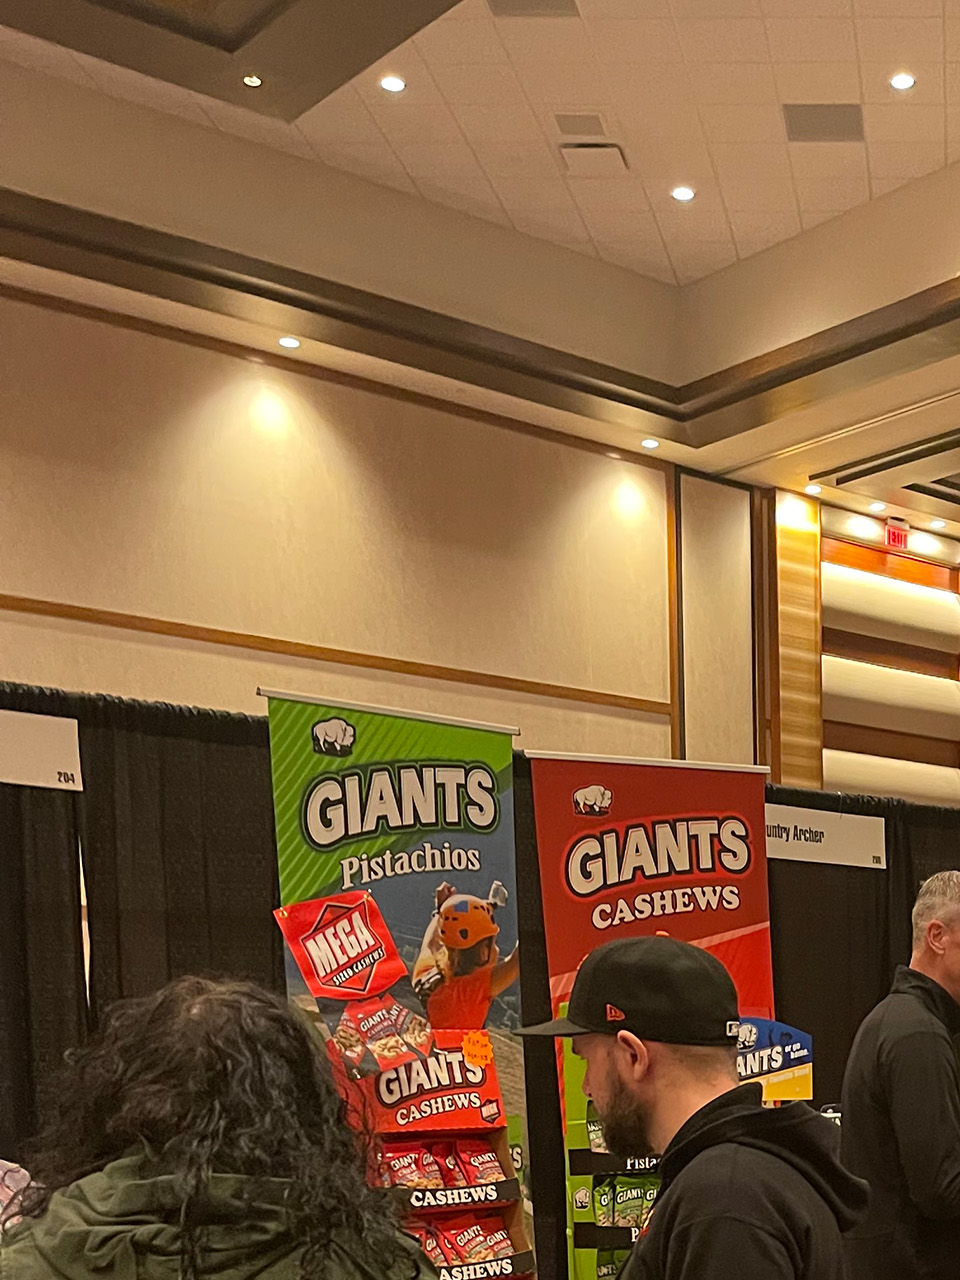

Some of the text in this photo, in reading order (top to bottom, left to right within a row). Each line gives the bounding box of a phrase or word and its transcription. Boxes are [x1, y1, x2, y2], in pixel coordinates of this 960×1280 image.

[306, 766, 496, 846] GIANTS
[766, 824, 825, 843] untry Archer
[340, 842, 481, 890] Pistachios
[568, 819, 749, 895] GIANTS
[592, 885, 740, 929] CASHEWS
[306, 911, 375, 978] MEGA
[332, 948, 385, 986] SIZED CASHEWS
[378, 1052, 484, 1104] GIANTS
[736, 1045, 783, 1077] ANTS
[396, 1092, 481, 1125] CASHEWS
[626, 1156, 662, 1170] Pista
[410, 1185, 498, 1207] CASHEWS
